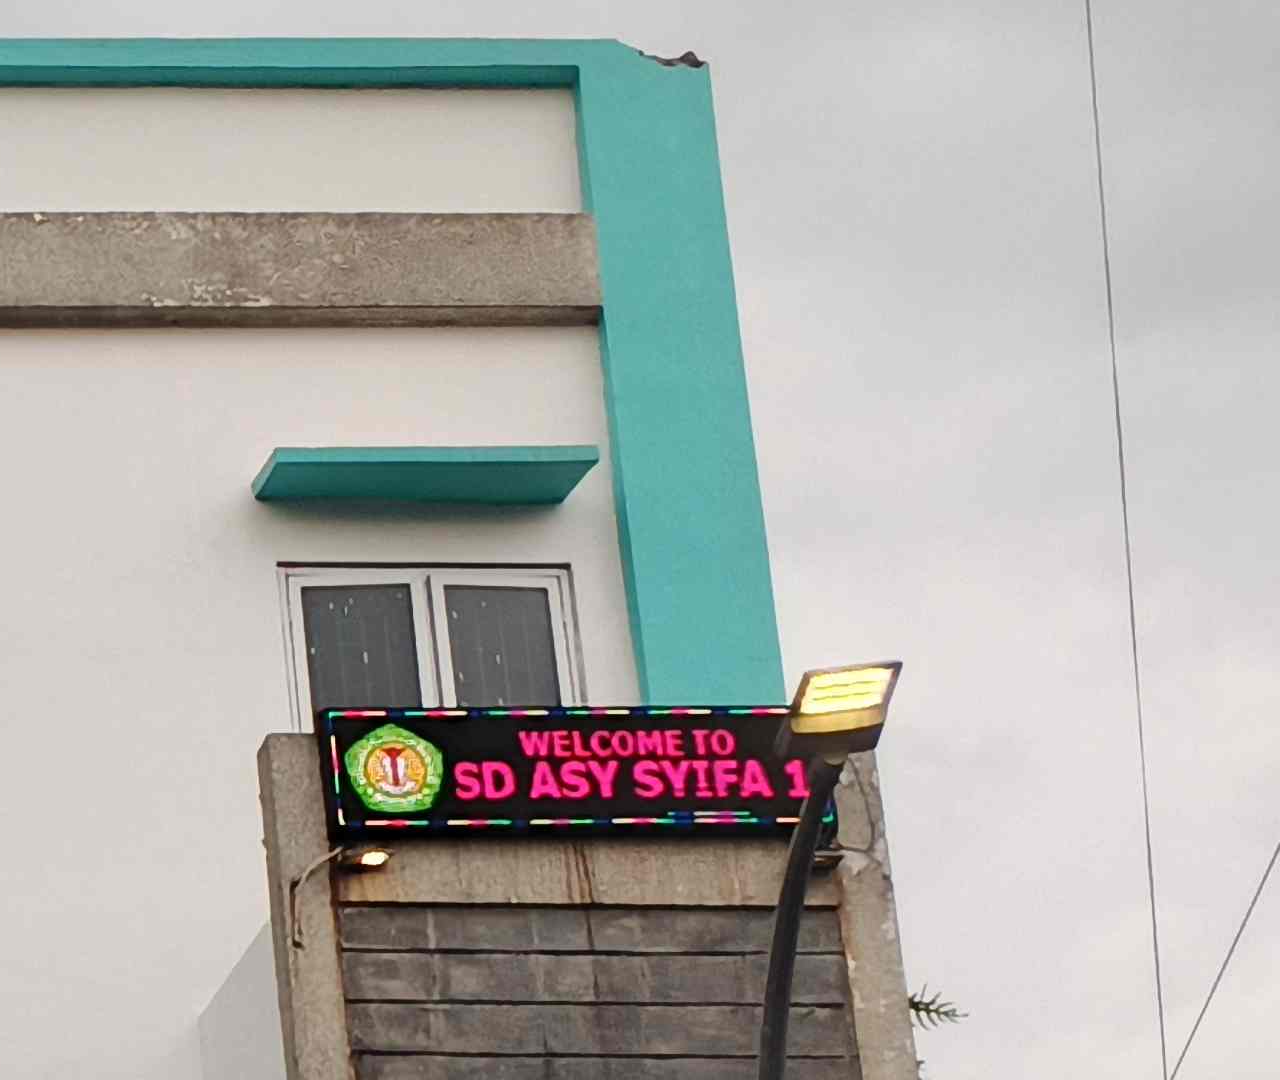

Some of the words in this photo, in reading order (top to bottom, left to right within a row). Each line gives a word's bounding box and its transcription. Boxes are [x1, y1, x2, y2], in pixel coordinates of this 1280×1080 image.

[518, 730, 684, 758] WELCOME
[691, 729, 736, 757] TO
[454, 760, 517, 800] SD
[529, 760, 620, 800] ASY
[632, 758, 775, 800] SYIFA
[784, 758, 812, 799] 1
